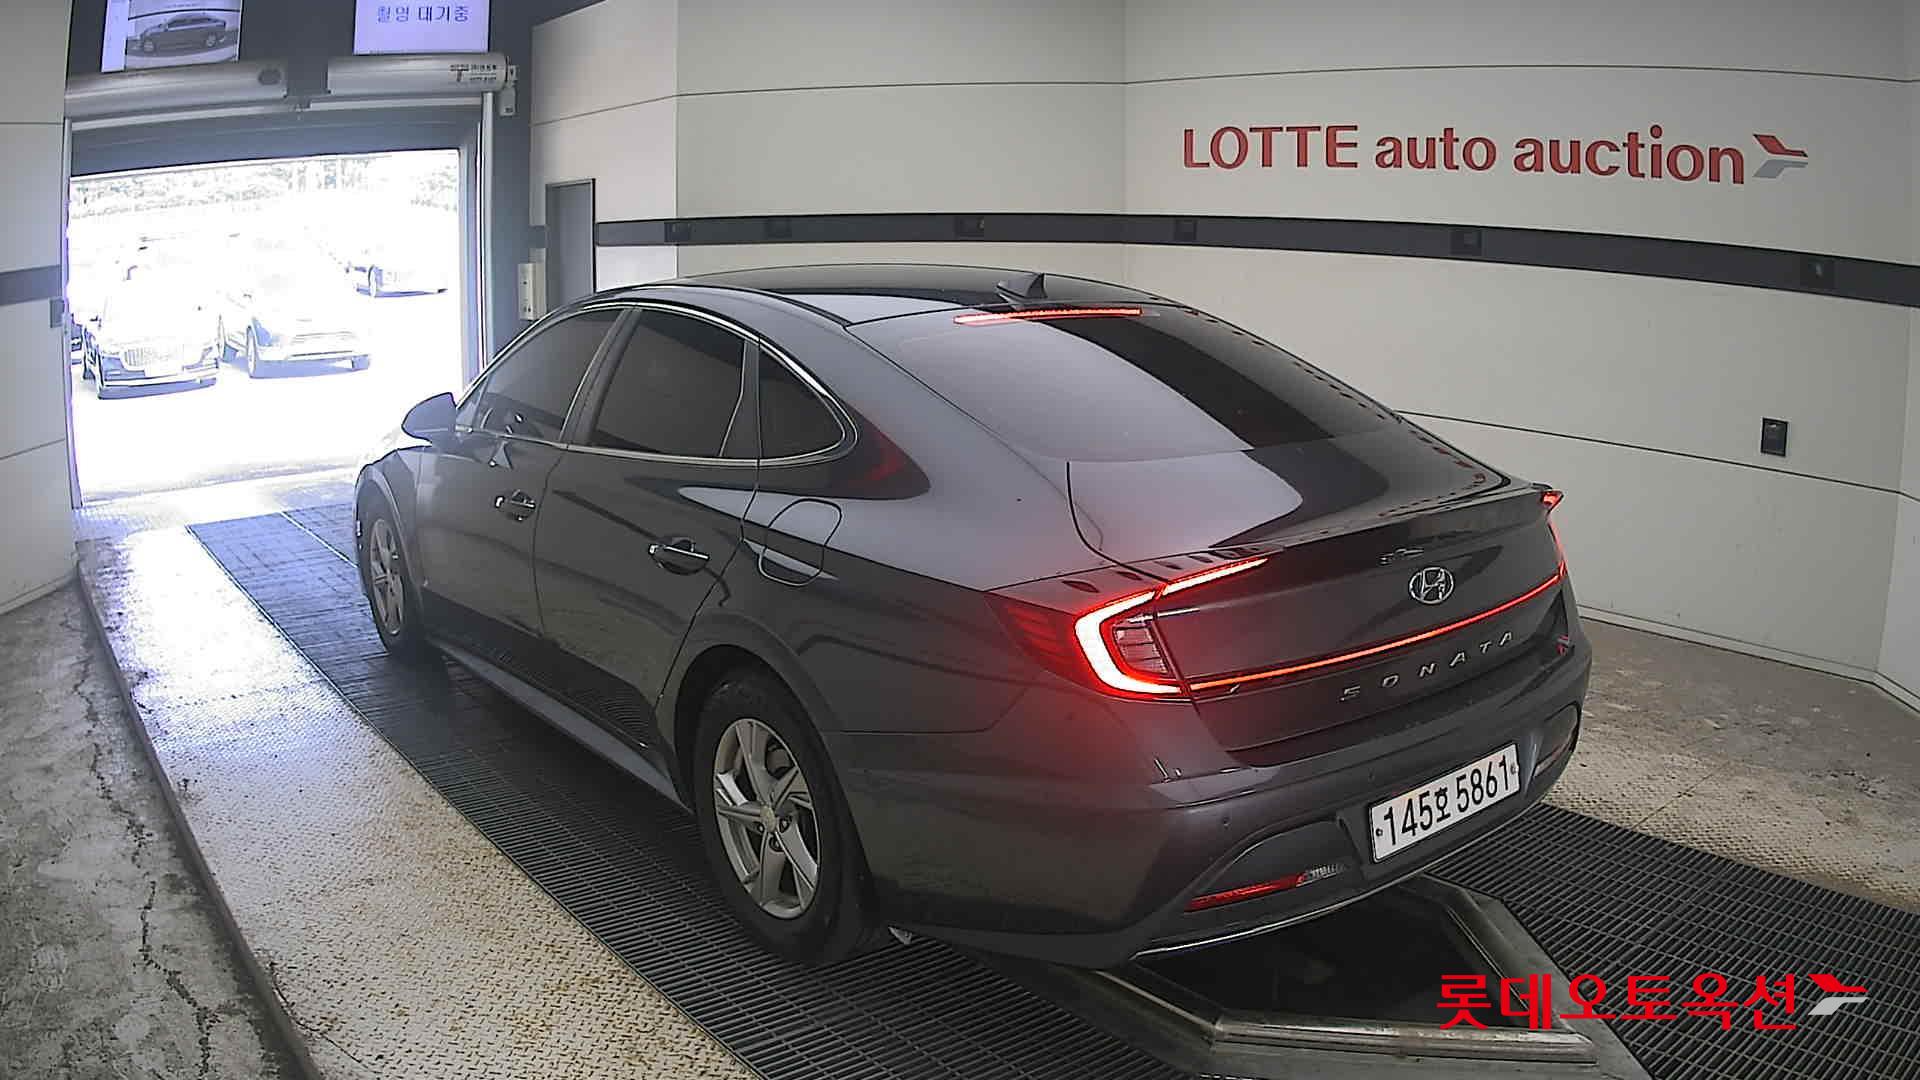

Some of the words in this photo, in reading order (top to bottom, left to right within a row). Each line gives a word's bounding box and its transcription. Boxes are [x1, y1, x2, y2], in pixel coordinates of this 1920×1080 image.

[418, 5, 469, 23] 대기중
[1183, 124, 1359, 170] LOTTE
[1374, 127, 1497, 171] auto
[1512, 123, 1746, 185] auction
[1339, 631, 1513, 702] SONATA
[1383, 787, 1451, 846] 145호
[1455, 754, 1509, 813] 5861
